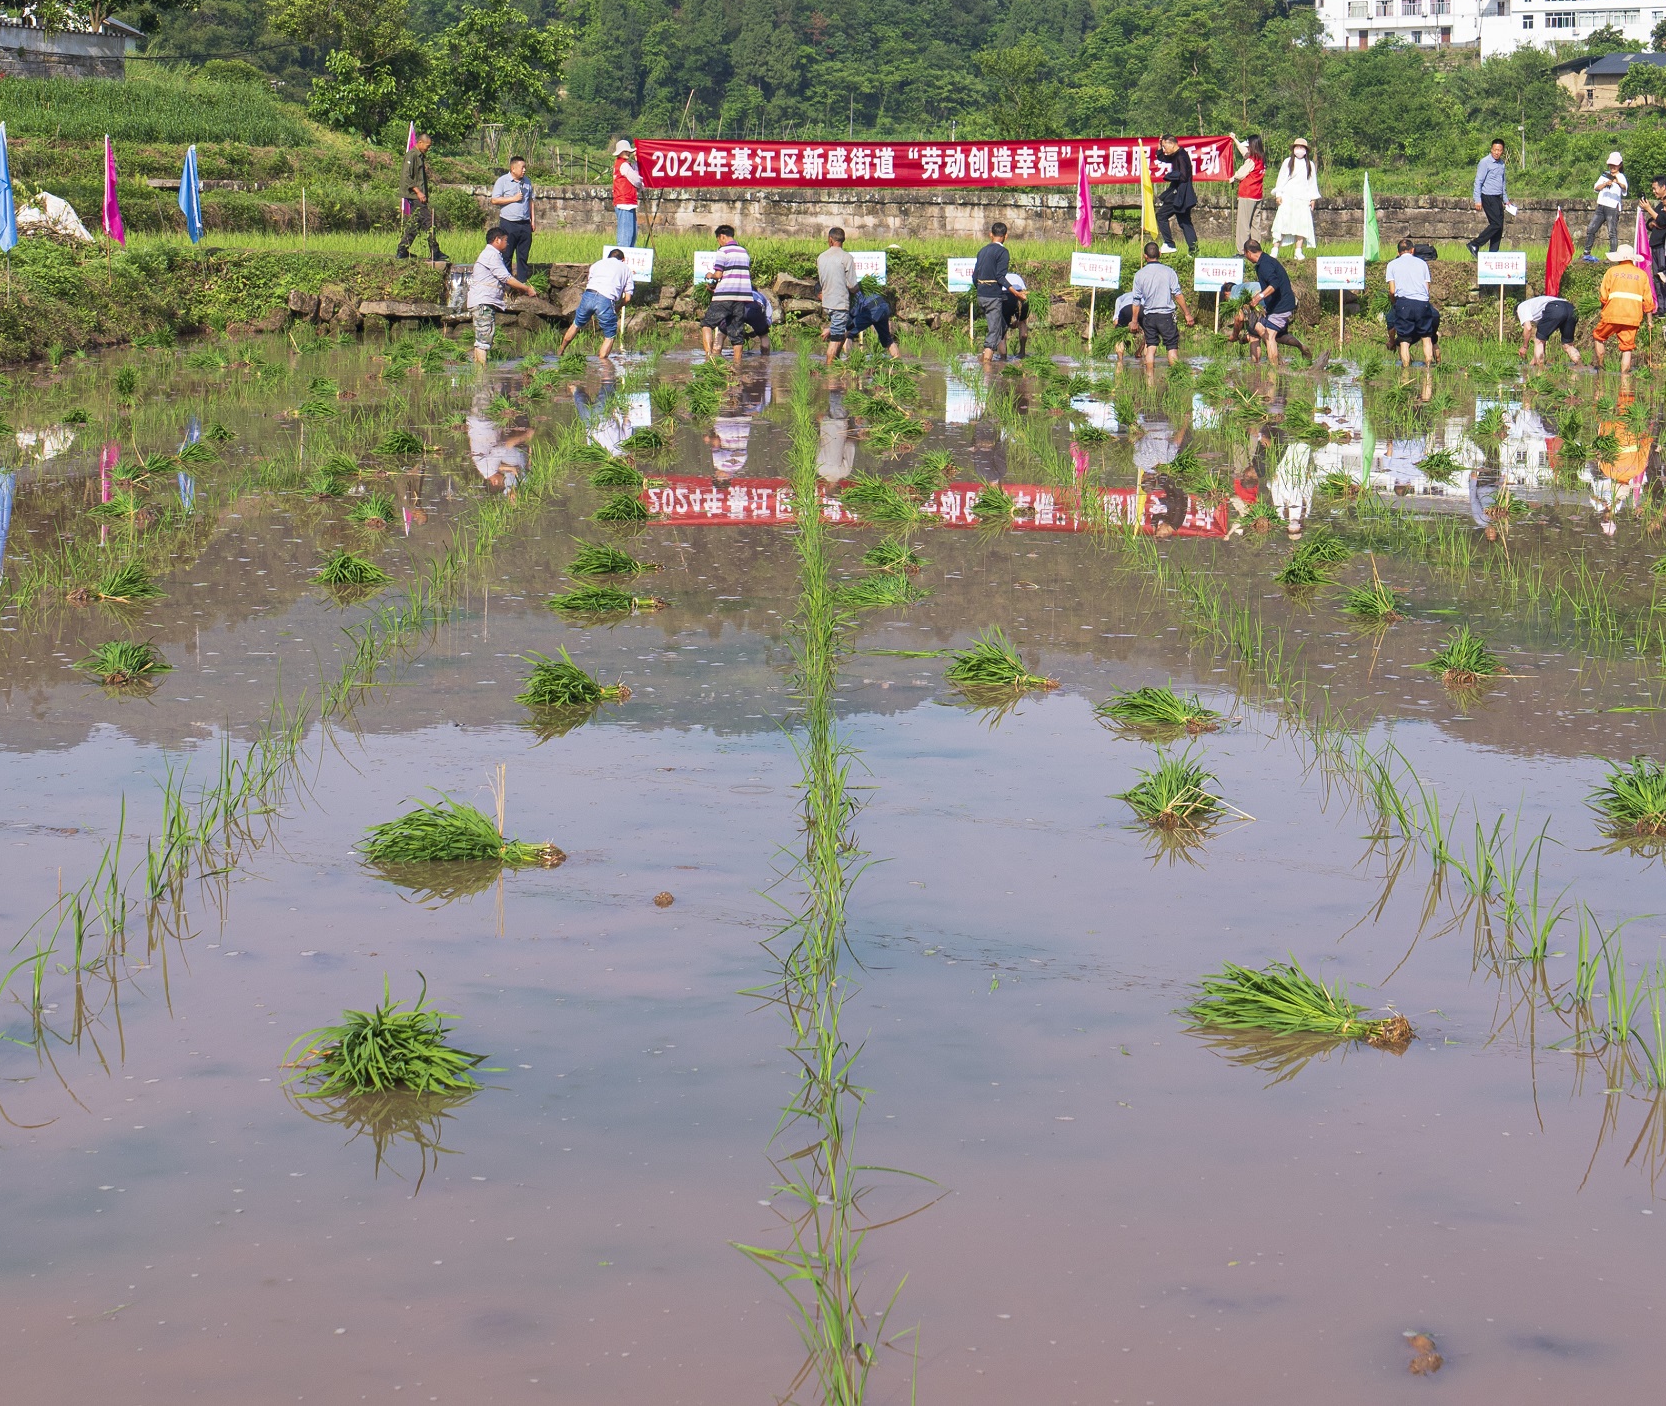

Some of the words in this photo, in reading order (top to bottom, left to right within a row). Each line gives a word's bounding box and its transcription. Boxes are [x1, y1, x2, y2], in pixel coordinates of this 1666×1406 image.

[1078, 262, 1114, 274] 气田5社
[1323, 265, 1359, 276] 气田7社
[1484, 261, 1520, 272] 气田8社
[1201, 267, 1237, 278] 气田6社
